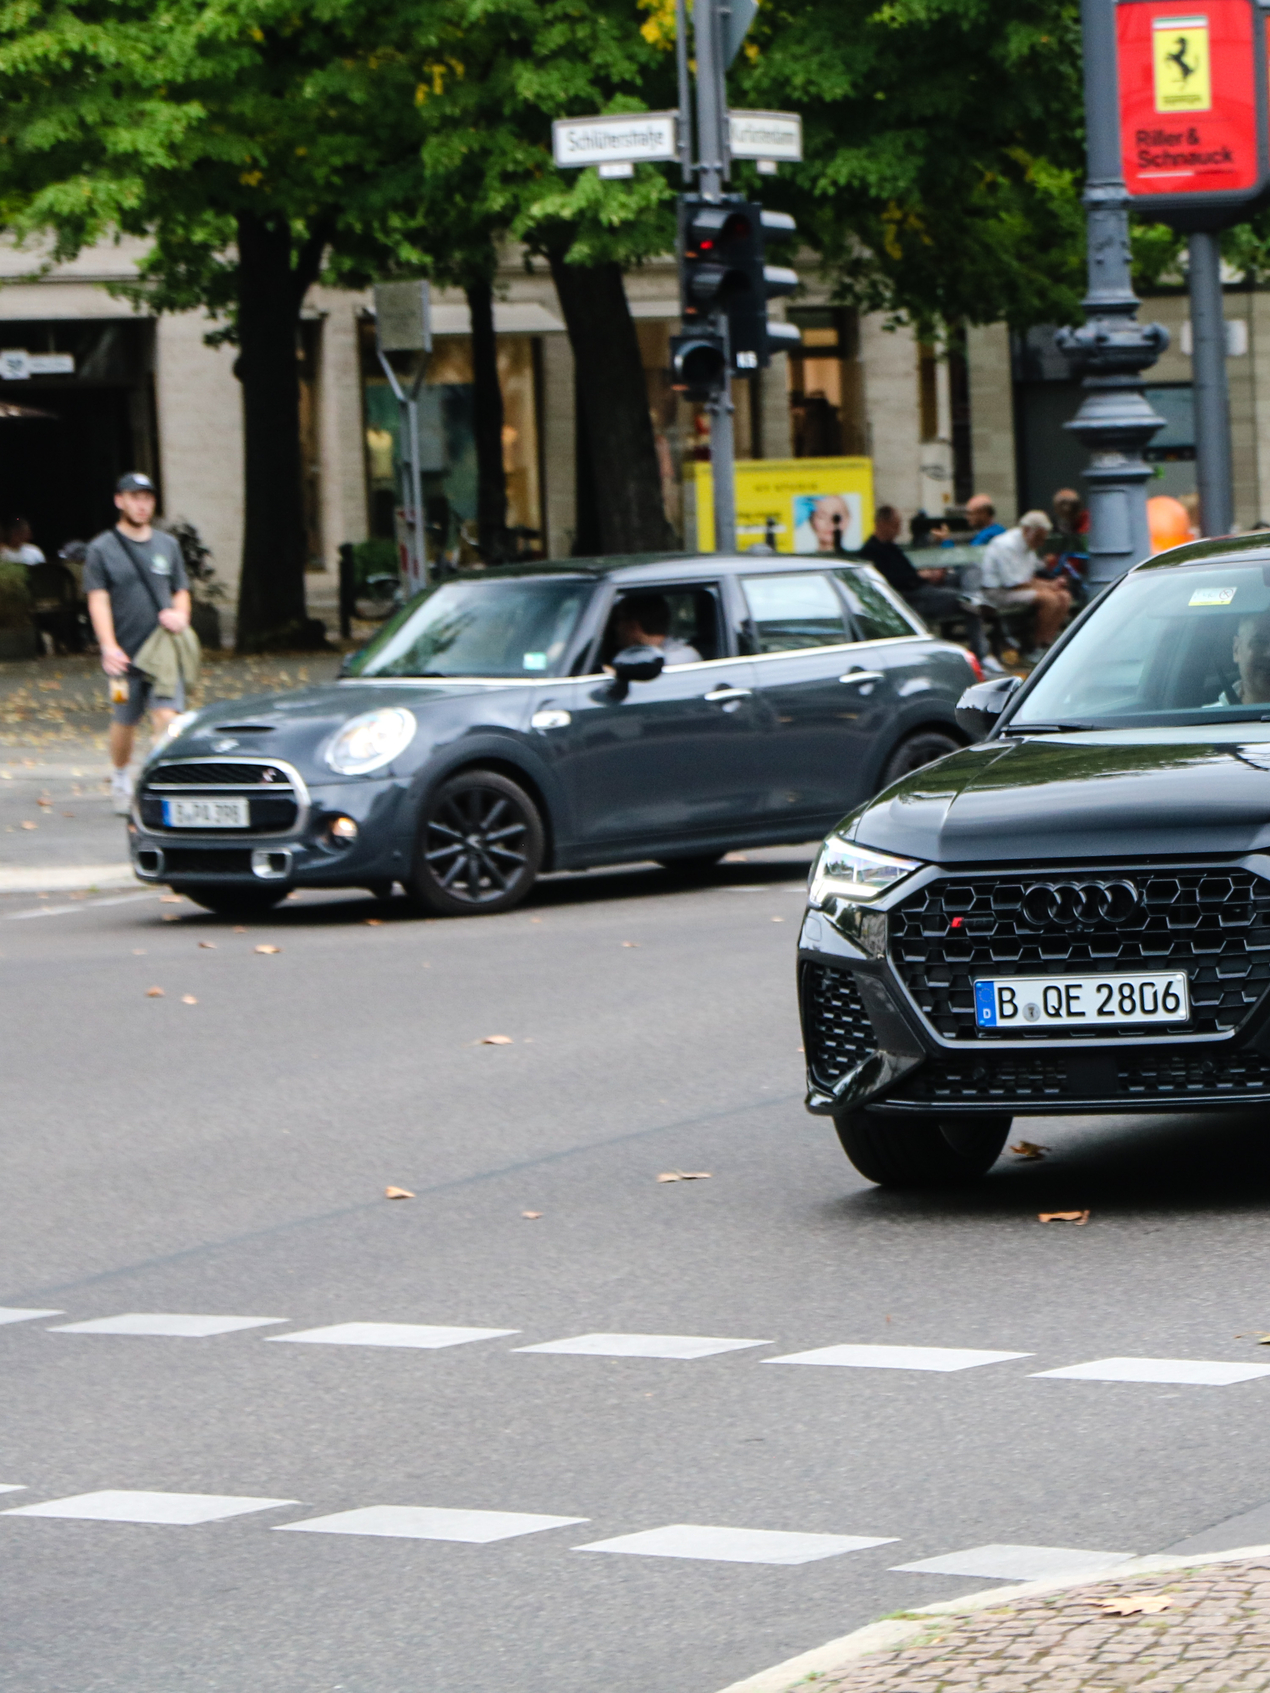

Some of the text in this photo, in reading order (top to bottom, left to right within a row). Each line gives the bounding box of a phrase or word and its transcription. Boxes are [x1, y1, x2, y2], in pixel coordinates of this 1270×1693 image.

[566, 128, 665, 151] Schlüterstraße
[1187, 127, 1200, 145] &
[1137, 145, 1233, 168] Schnauck
[997, 980, 1181, 1019] B QE 2806
[982, 1008, 991, 1019] D
